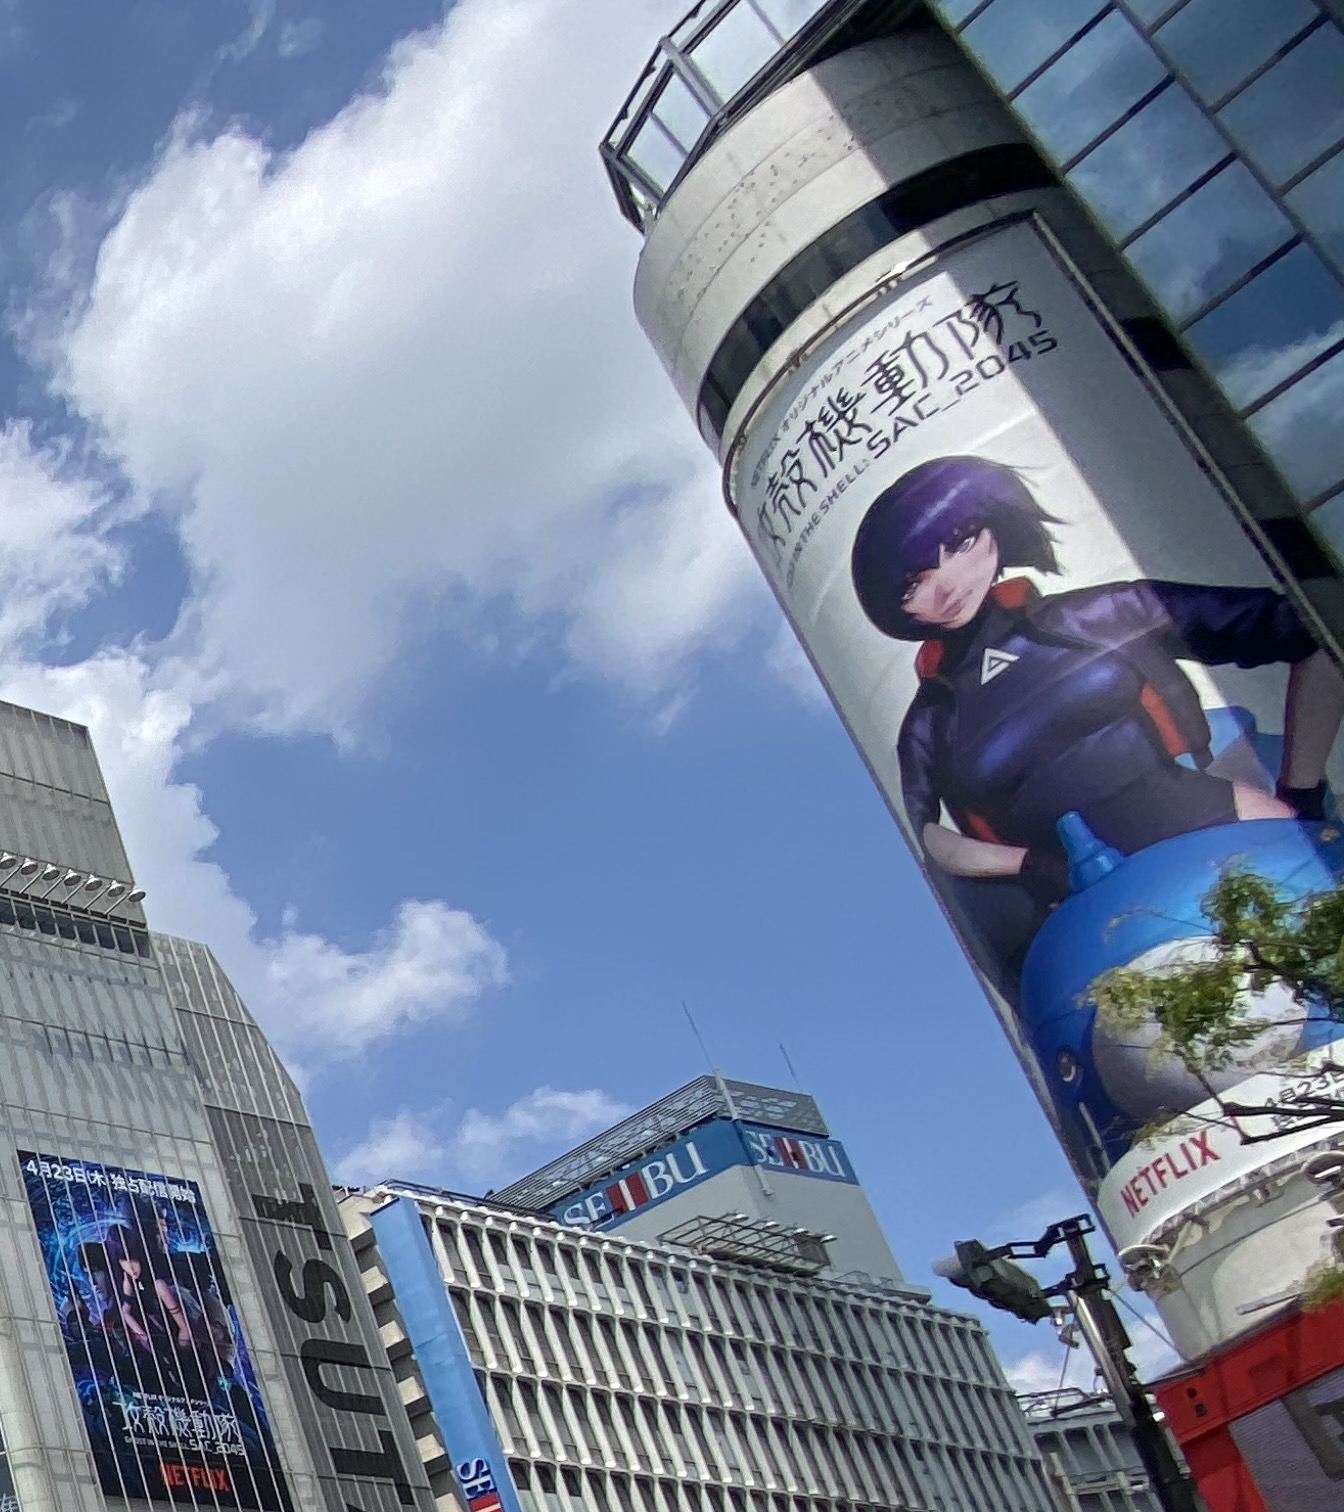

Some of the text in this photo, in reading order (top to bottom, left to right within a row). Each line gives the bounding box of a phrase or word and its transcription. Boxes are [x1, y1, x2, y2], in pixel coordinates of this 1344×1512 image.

[866, 330, 1058, 460] SAC_2045
[563, 1141, 709, 1229] SEIBU
[744, 1131, 846, 1178] SEIBU
[1120, 1131, 1220, 1219] NETFLIX
[161, 1464, 230, 1491] NETFLIX
